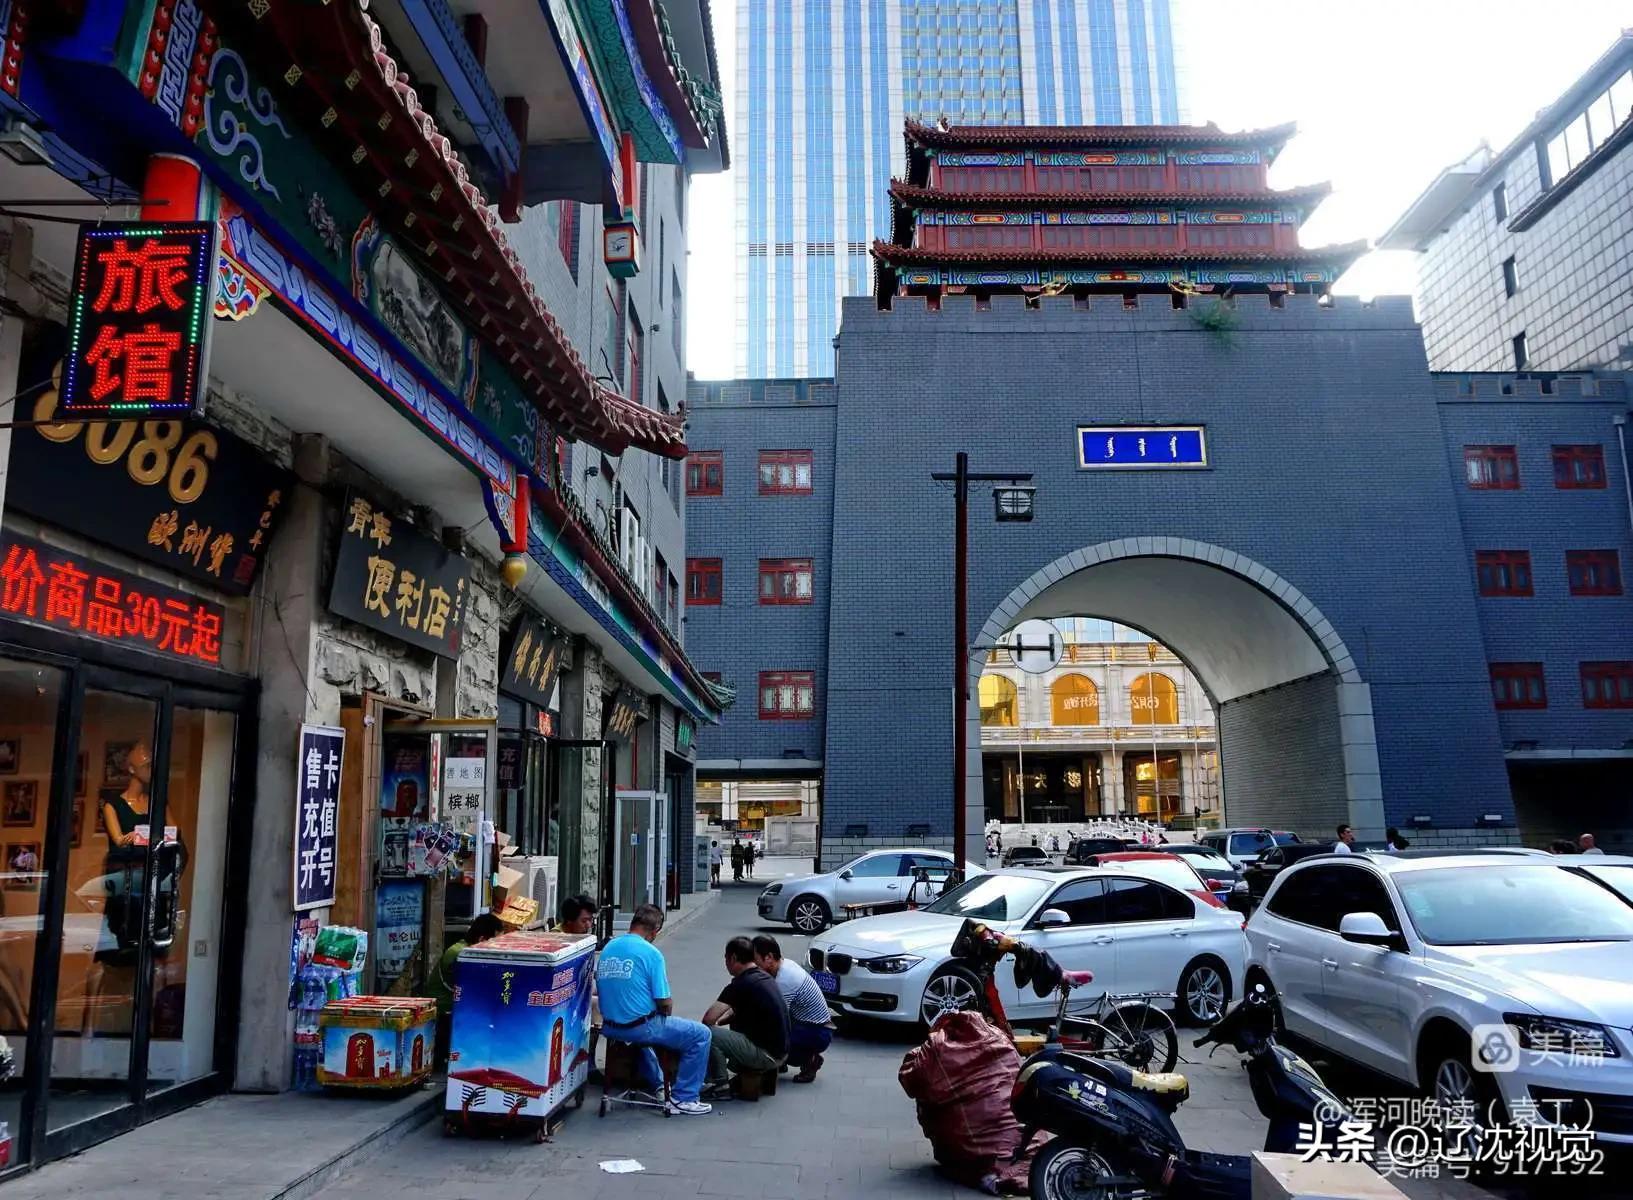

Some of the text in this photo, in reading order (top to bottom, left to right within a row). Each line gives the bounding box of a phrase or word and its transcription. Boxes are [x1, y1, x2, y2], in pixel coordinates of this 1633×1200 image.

[86, 239, 191, 401] 旅馆
[0, 544, 220, 664] 价商品30元起
[364, 555, 451, 639] 便利店
[305, 748, 338, 789] 售卡
[302, 797, 336, 839] 充值
[448, 793, 480, 811] 槟榔
[301, 847, 333, 889] 开号
